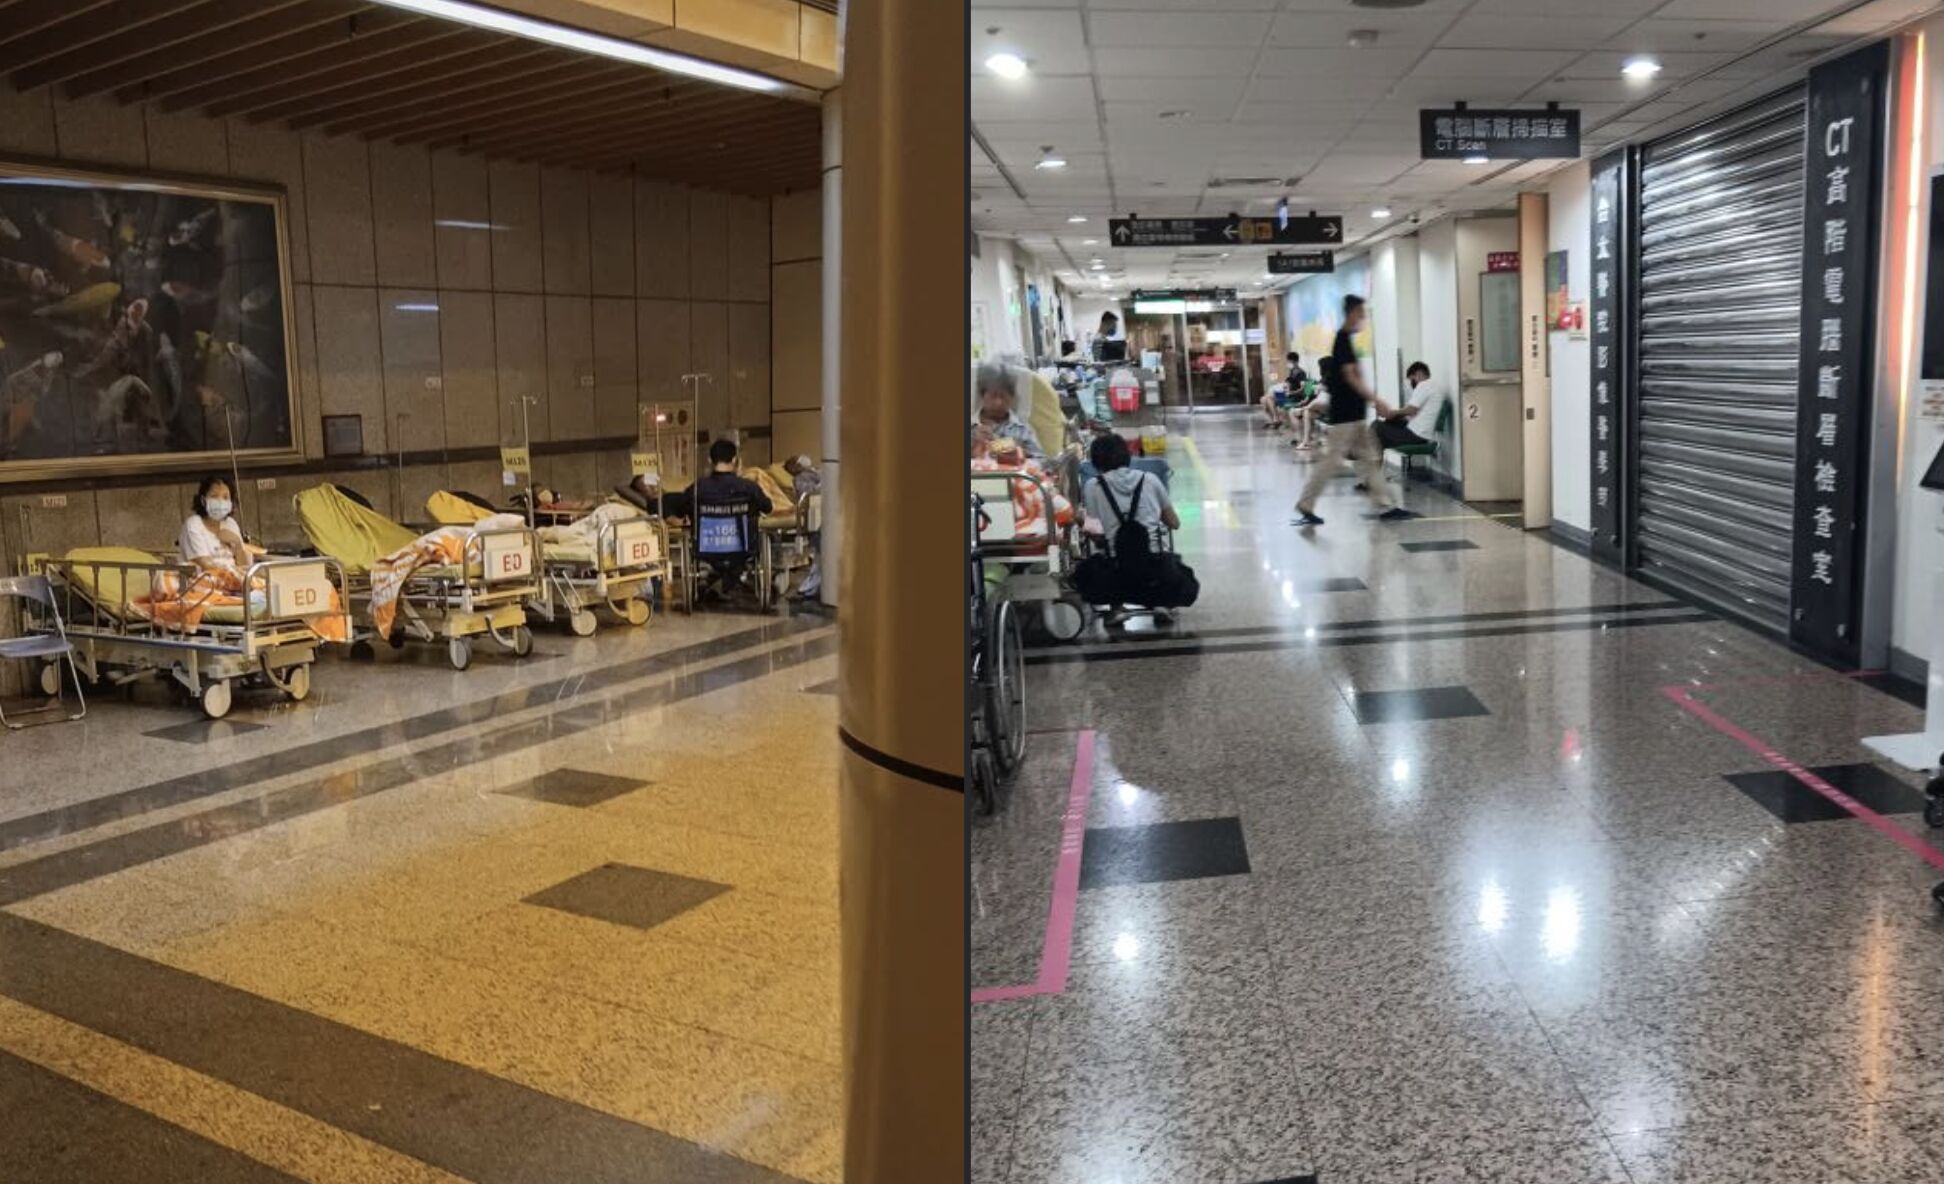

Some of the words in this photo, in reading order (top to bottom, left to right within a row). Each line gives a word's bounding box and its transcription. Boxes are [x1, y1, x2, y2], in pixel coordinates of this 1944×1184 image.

[1435, 140, 1452, 151] CT
[1456, 140, 1487, 151] Scan
[1468, 404, 1479, 419] 2
[632, 542, 650, 560] ED
[502, 553, 522, 572] ED
[294, 588, 317, 606] ED
